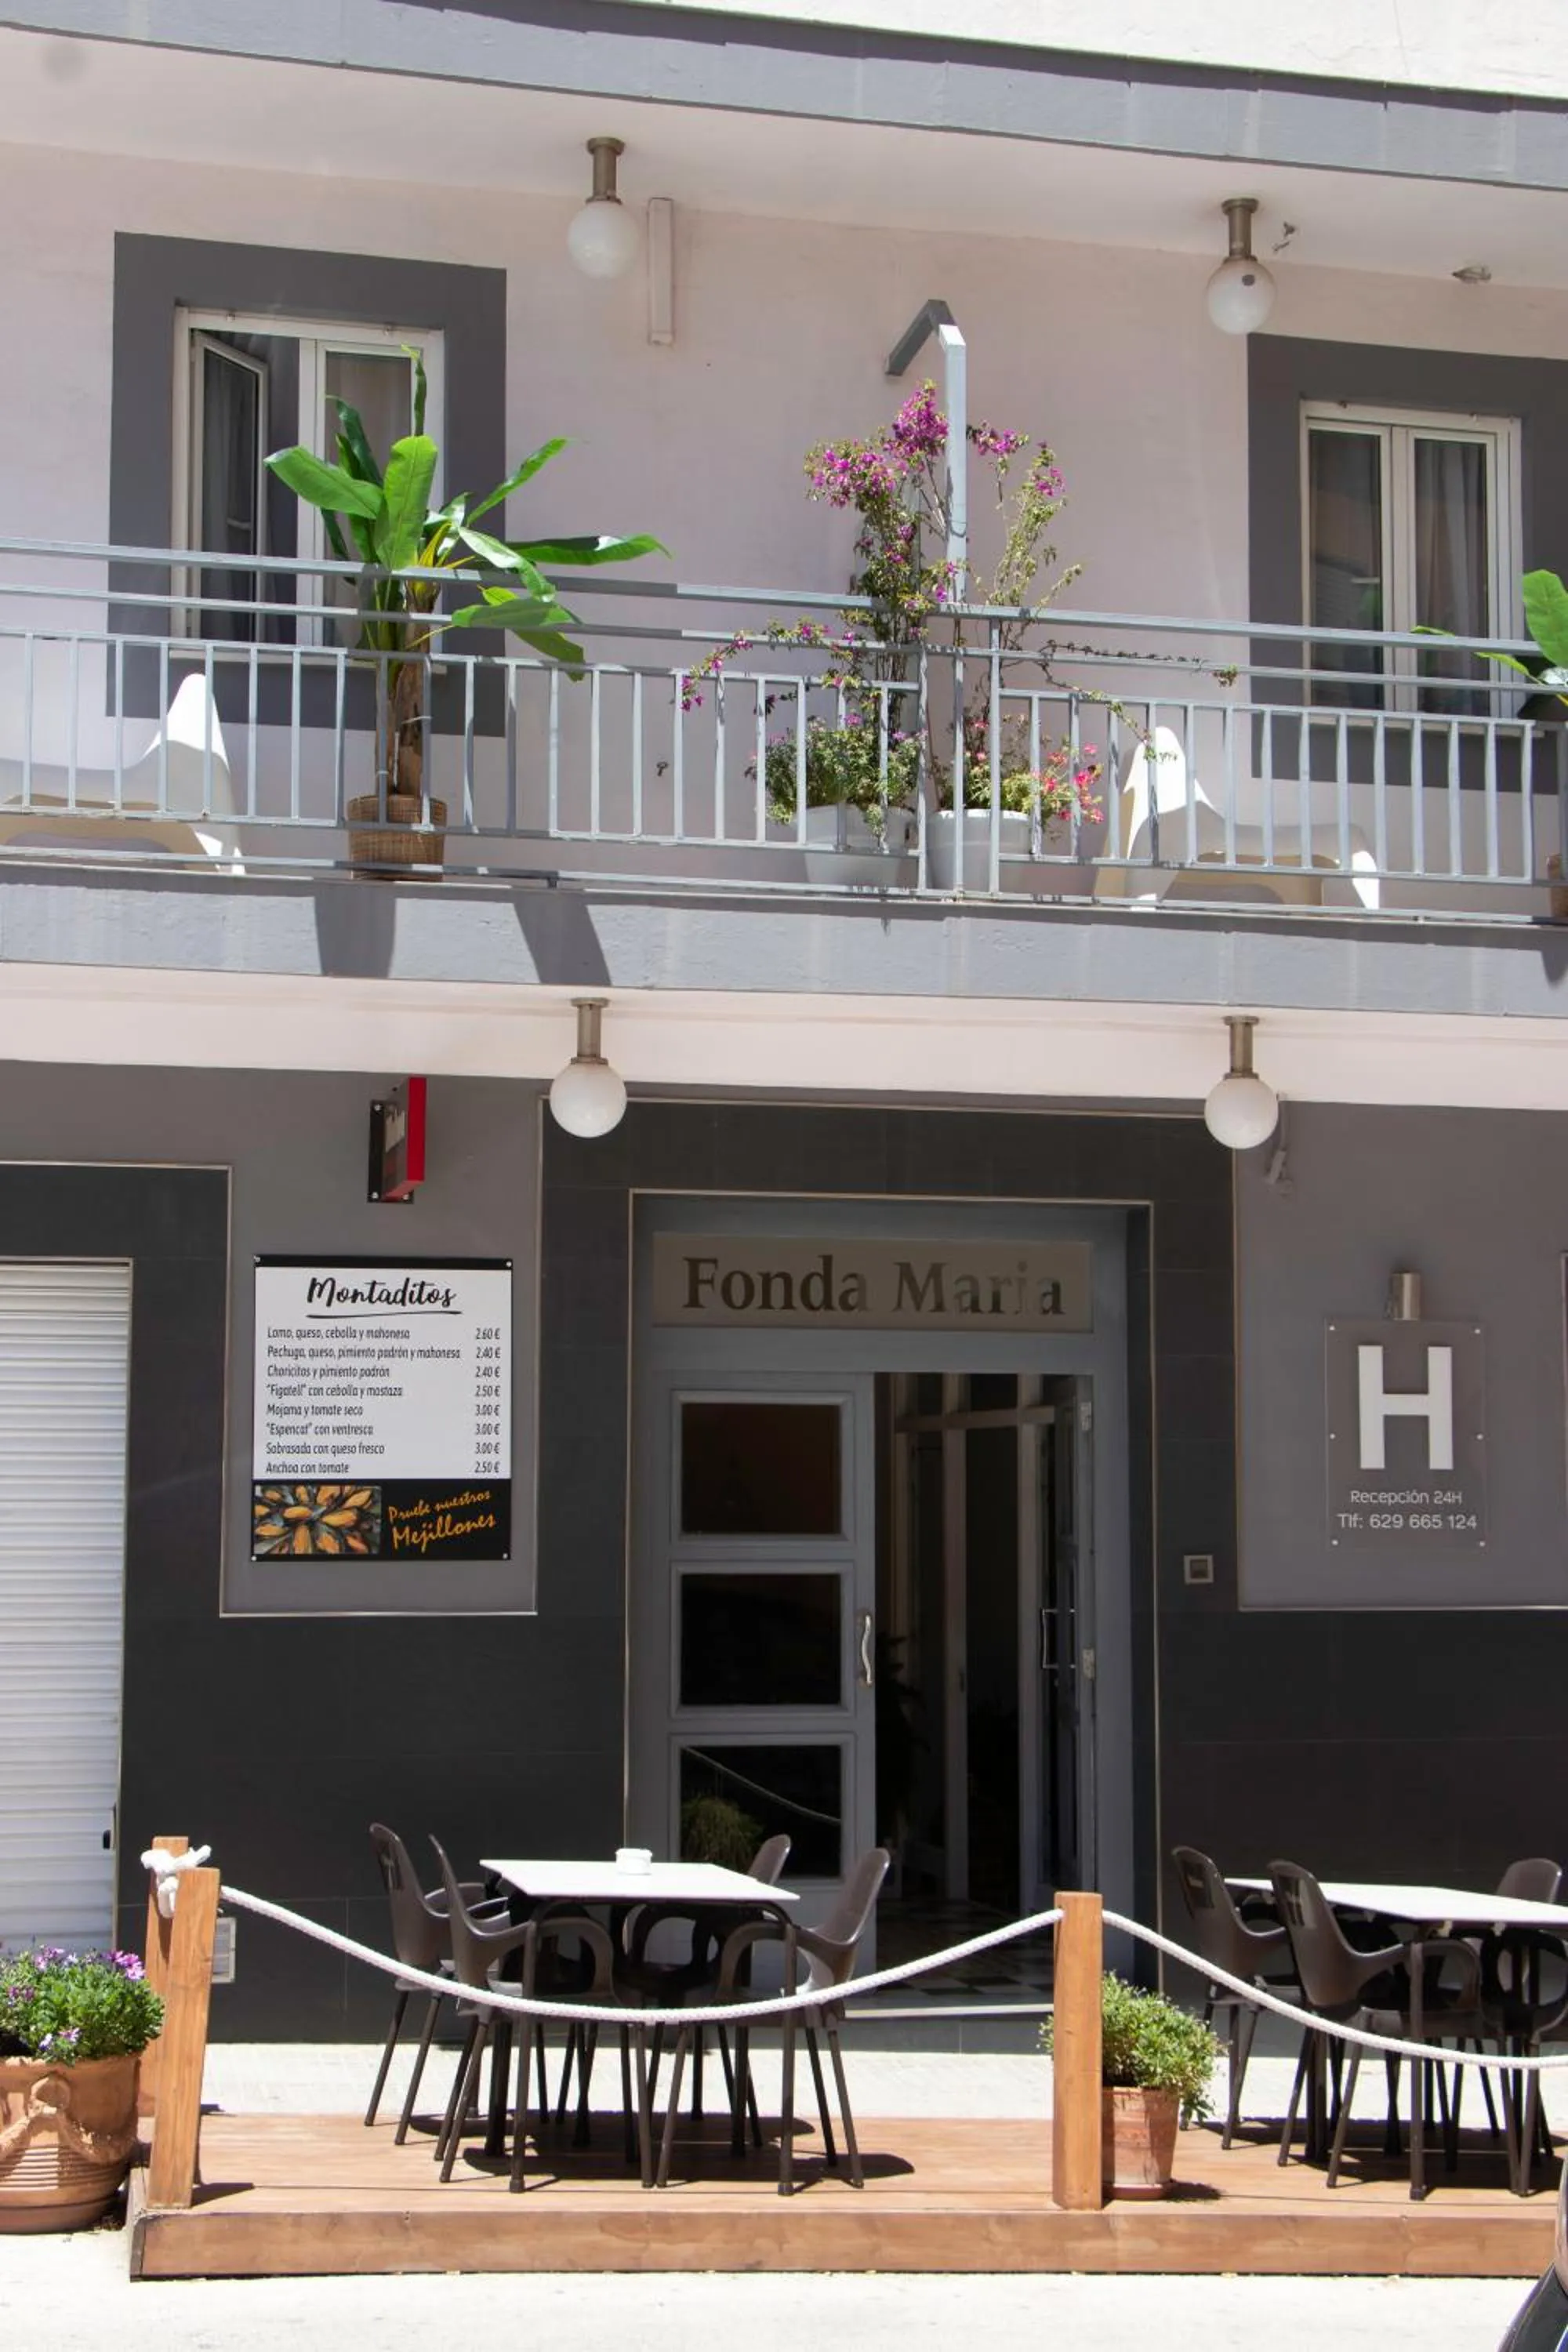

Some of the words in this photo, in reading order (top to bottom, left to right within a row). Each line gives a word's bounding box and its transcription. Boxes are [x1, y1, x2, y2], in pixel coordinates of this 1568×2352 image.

[682, 1254, 868, 1312] Fonda
[306, 1276, 457, 1308] Montaditos
[267, 1326, 294, 1339] Lomo,
[296, 1328, 324, 1341] queso,
[325, 1326, 357, 1339] cebolla
[358, 1329, 364, 1341] y
[366, 1327, 410, 1340] mahonesa
[267, 1345, 307, 1360] Pechuga,
[308, 1347, 336, 1361] queso,
[338, 1346, 376, 1361] pimiento
[409, 1348, 416, 1361] y
[416, 1346, 461, 1359] mahonesa
[267, 1364, 311, 1377] Choricitos
[312, 1368, 318, 1379] y
[319, 1365, 358, 1380] pimiento
[308, 1386, 324, 1396] con
[325, 1385, 358, 1396] cebolla
[359, 1388, 365, 1399] y
[366, 1386, 403, 1396] mostaza
[266, 1403, 303, 1417] Mojama
[303, 1406, 310, 1417] y
[310, 1404, 342, 1416] tomate
[343, 1405, 364, 1416] seco
[1358, 1345, 1454, 1470] H
[314, 1425, 330, 1436] con
[332, 1424, 374, 1436] ventresca
[266, 1442, 312, 1455] Sobrasada
[313, 1444, 328, 1454] con
[331, 1444, 357, 1457] queso
[358, 1442, 385, 1455] fresco
[266, 1461, 299, 1474] Anchoa
[300, 1464, 316, 1474] con
[318, 1462, 350, 1474] tomate
[434, 1490, 492, 1512] nuestros
[1350, 1490, 1429, 1506] Recepción
[1433, 1491, 1463, 1504] 24H
[1338, 1513, 1363, 1530] Tlf:
[1369, 1514, 1403, 1529] 629
[1409, 1515, 1443, 1530] 665
[1449, 1515, 1477, 1530] 124
[393, 1512, 497, 1554] Mejillones
